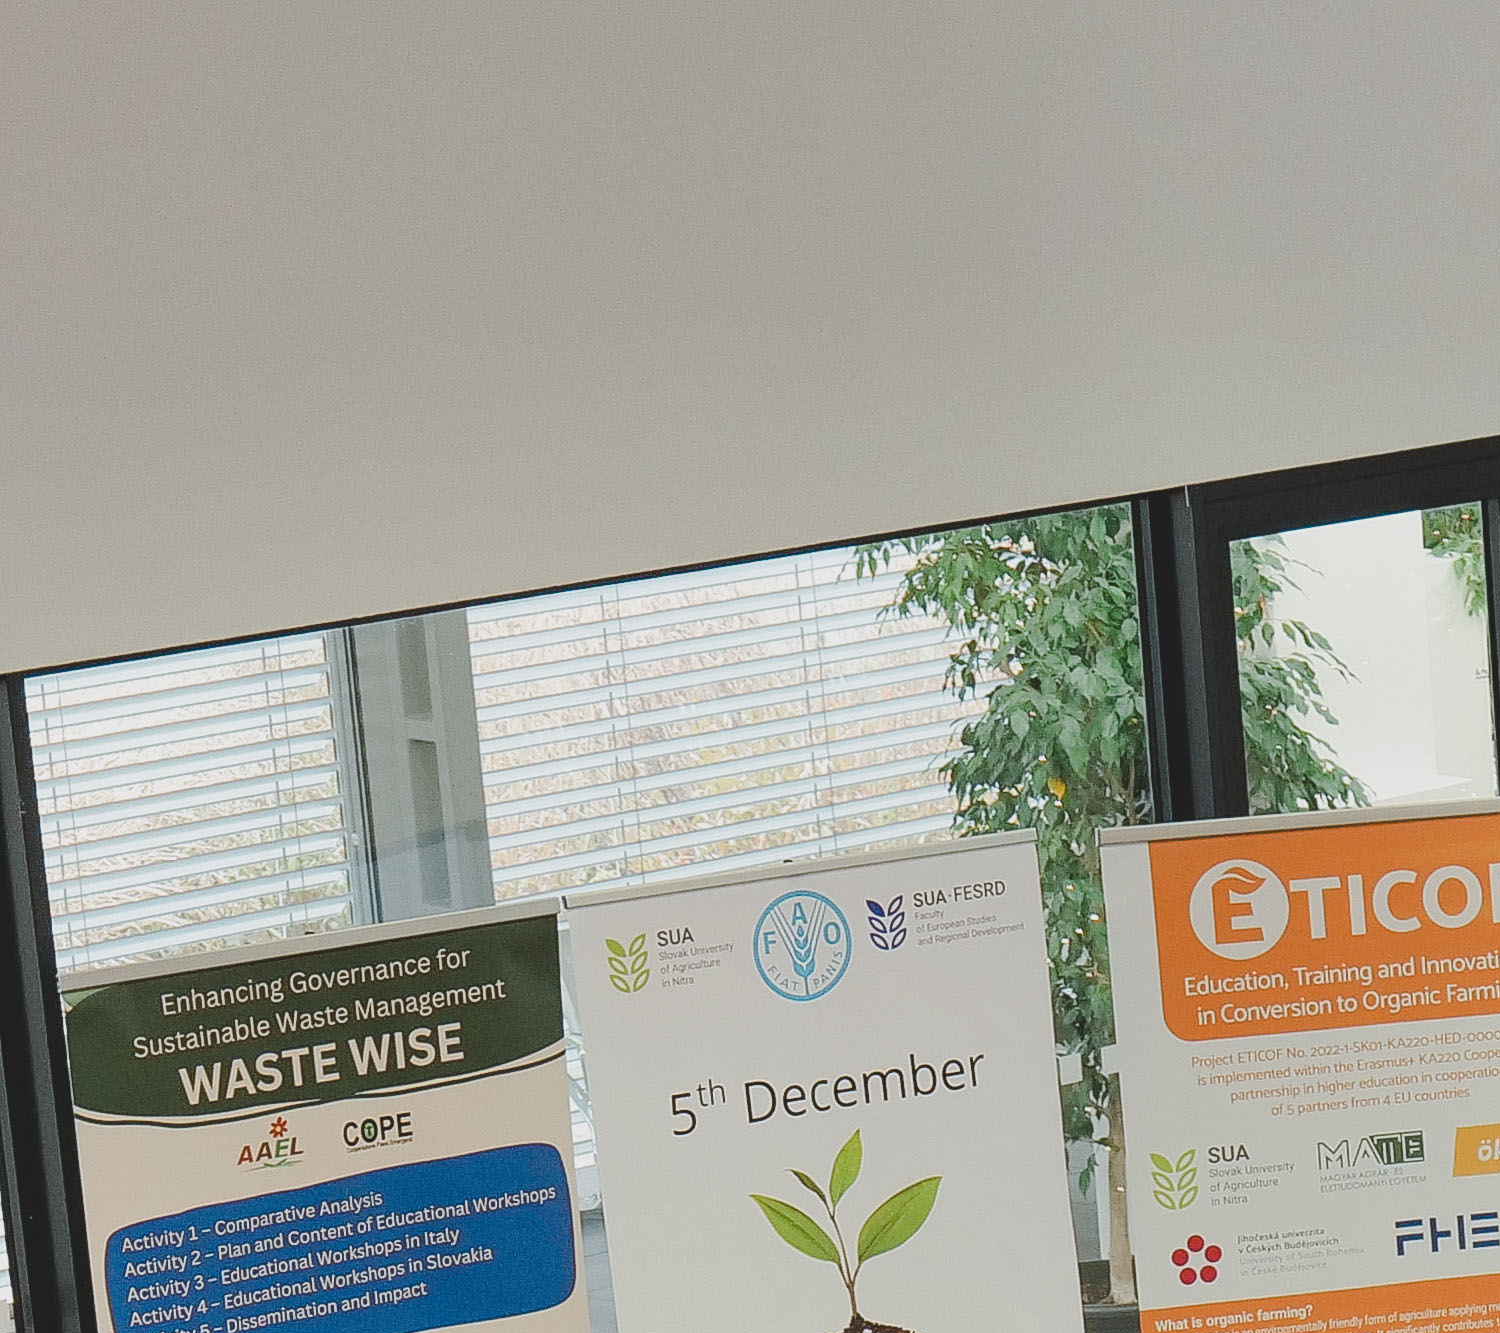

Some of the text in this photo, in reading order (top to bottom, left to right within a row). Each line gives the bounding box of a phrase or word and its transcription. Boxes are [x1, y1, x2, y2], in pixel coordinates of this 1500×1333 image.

[657, 927, 694, 946] SUA
[161, 948, 470, 1015] Enhancing Governance for
[1184, 971, 1288, 995] Education,
[1292, 963, 1372, 985] Training
[1378, 956, 1414, 978] and
[134, 979, 506, 1057] Sustainable Waste Management
[1197, 1006, 1215, 1025] in
[1221, 997, 1331, 1022] Conversion
[1336, 996, 1357, 1012] to
[1362, 986, 1440, 1013] Organic
[178, 1022, 464, 1104] WASTE WISE
[671, 1054, 983, 1136] 5th December
[237, 1137, 304, 1165] AAEL
[344, 1112, 413, 1146] COPE
[122, 1193, 382, 1252] Activity 1 Comparative Analysis
[124, 1187, 555, 1277] Activity 2 Plan and Content of Educational Workshops
[226, 1301, 337, 1333] Dissemination
[341, 1291, 370, 1311] and
[374, 1282, 427, 1304] Impact
